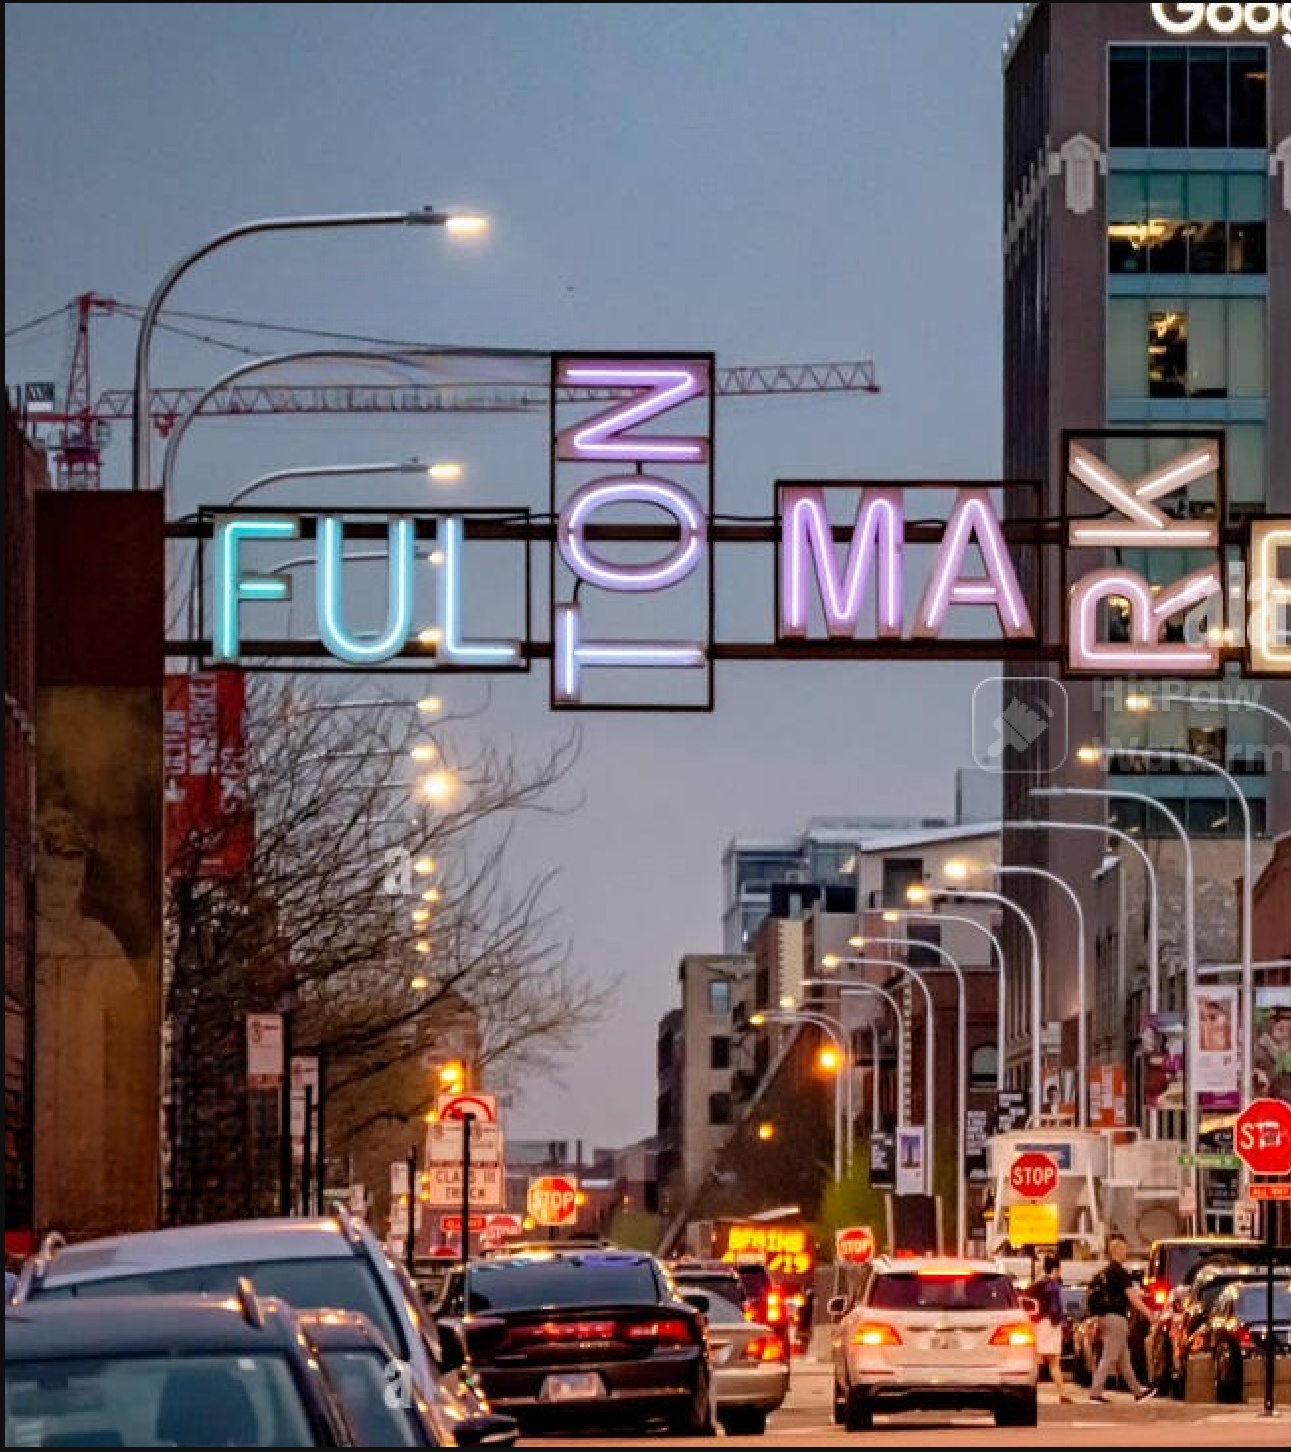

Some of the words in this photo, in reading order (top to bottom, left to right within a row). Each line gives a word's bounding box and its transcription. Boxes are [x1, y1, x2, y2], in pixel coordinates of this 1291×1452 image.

[1013, 1166, 1054, 1186] STOP
[533, 1190, 575, 1207] STOP
[840, 1240, 872, 1256] STOP
